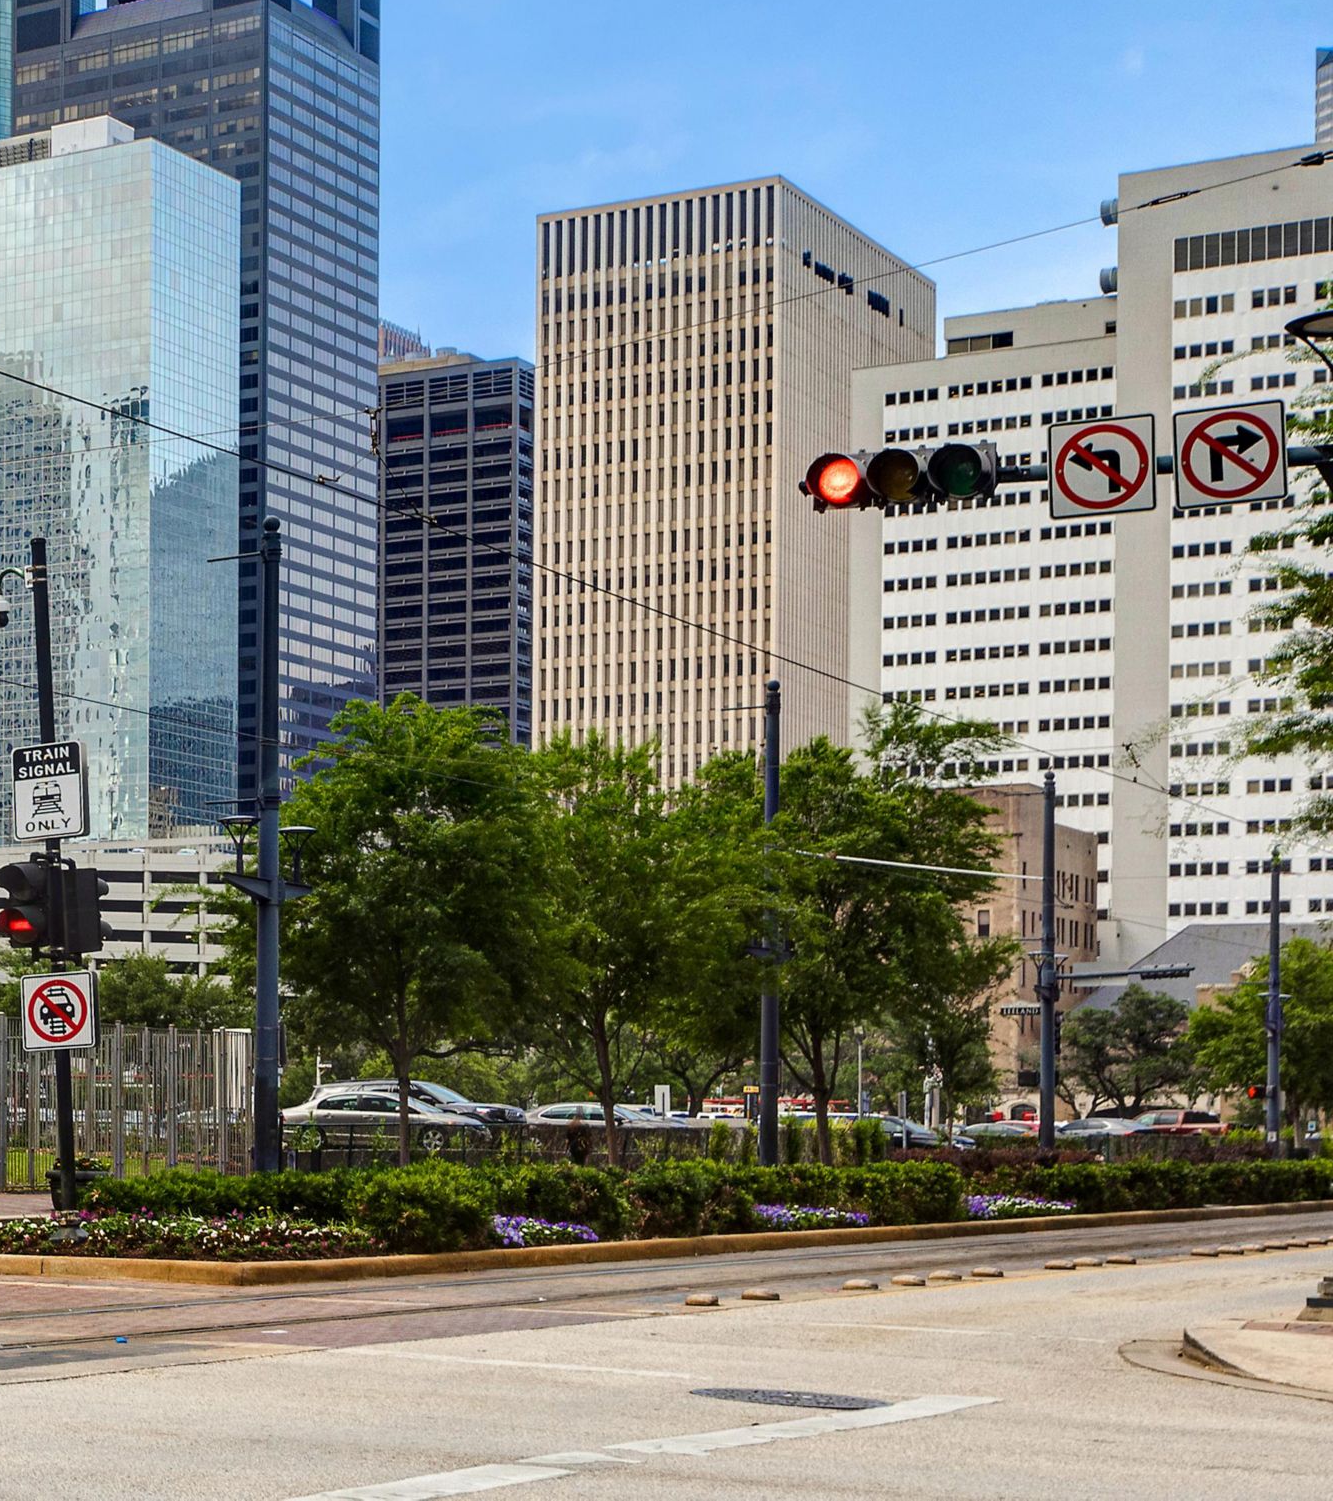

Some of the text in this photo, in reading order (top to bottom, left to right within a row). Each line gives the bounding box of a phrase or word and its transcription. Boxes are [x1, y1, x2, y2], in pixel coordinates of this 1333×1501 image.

[23, 746, 70, 763] TRAIN
[18, 761, 76, 779] SIGNAL
[25, 817, 71, 833] ONLY
